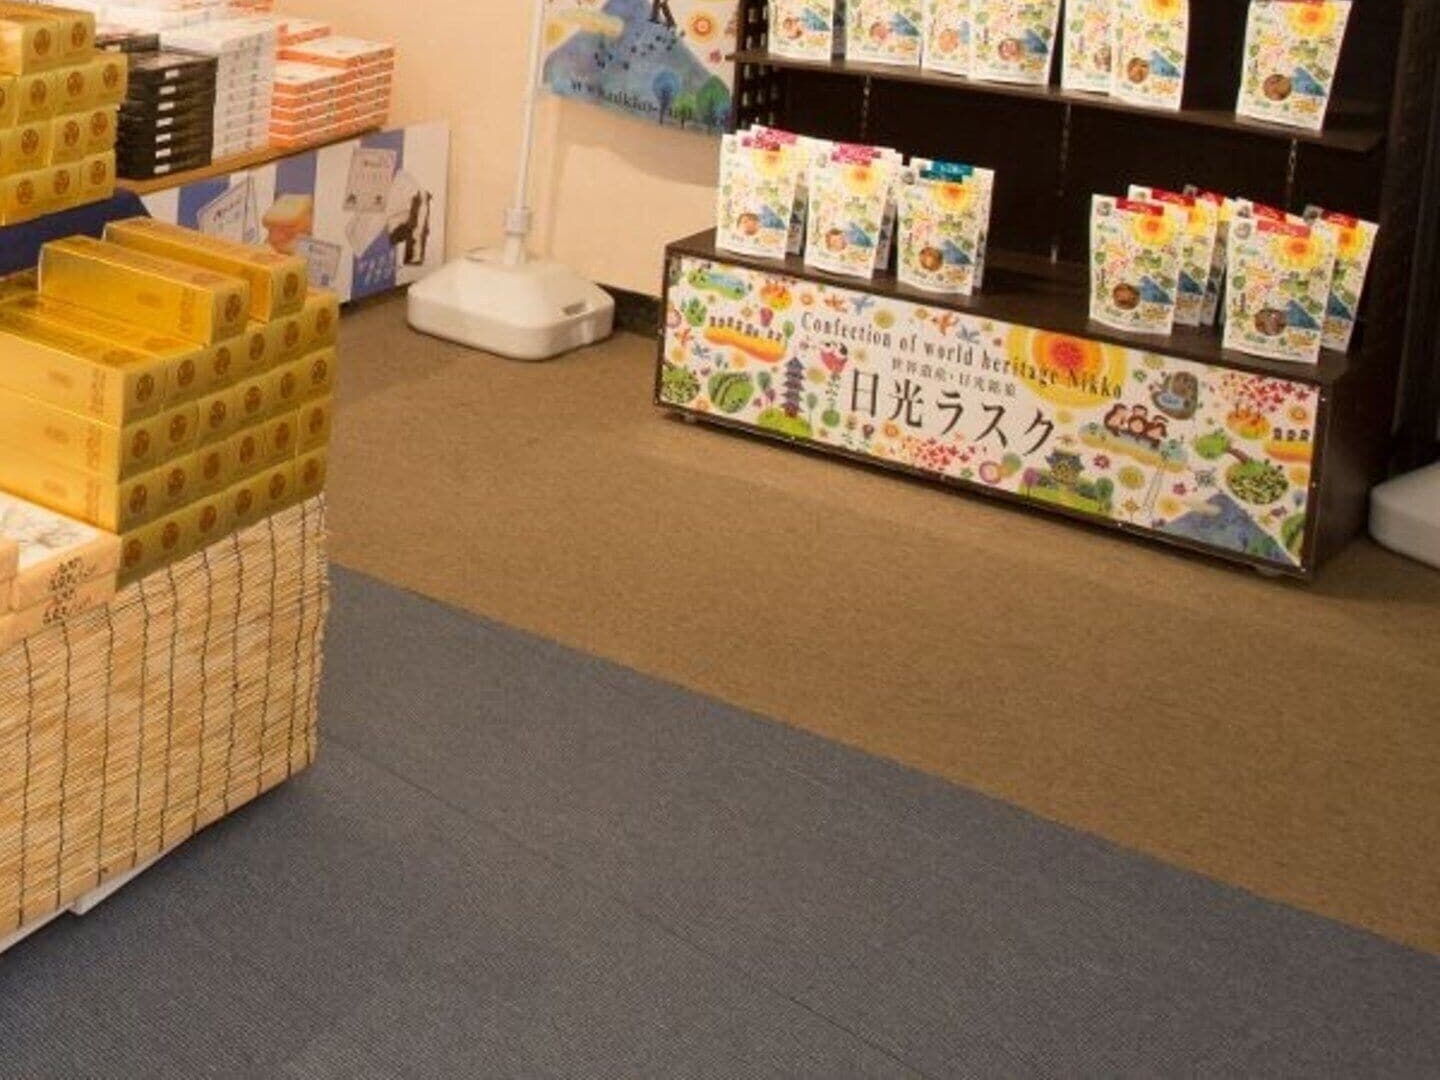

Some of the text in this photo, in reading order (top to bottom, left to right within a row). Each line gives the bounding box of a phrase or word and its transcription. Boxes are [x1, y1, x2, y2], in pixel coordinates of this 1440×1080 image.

[800, 311, 1123, 399] Confection of world heritage Nikko
[850, 368, 1055, 457] 日光ラスク
